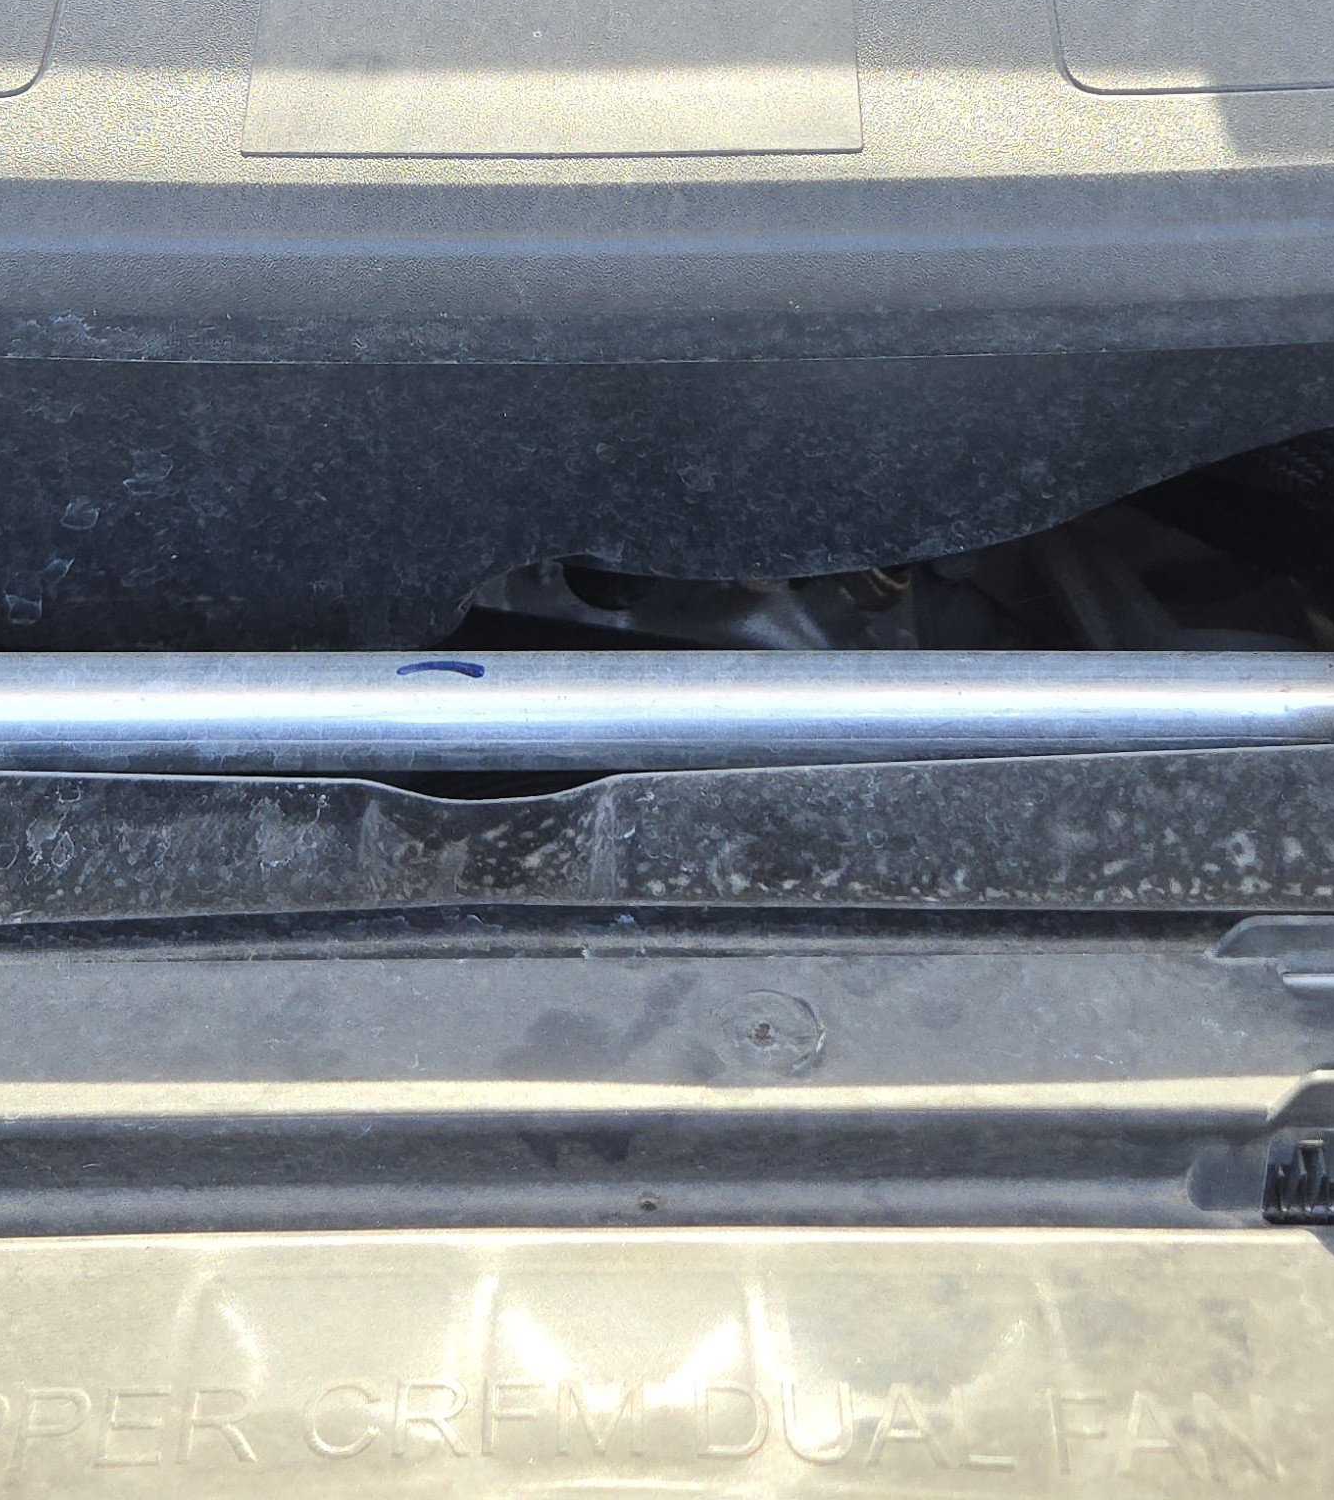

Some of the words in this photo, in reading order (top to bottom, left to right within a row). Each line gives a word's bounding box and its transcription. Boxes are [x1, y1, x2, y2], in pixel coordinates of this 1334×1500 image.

[304, 1376, 645, 1459] CRFM
[695, 1380, 1016, 1471] DUAL
[1046, 1387, 1286, 1484] FAN
